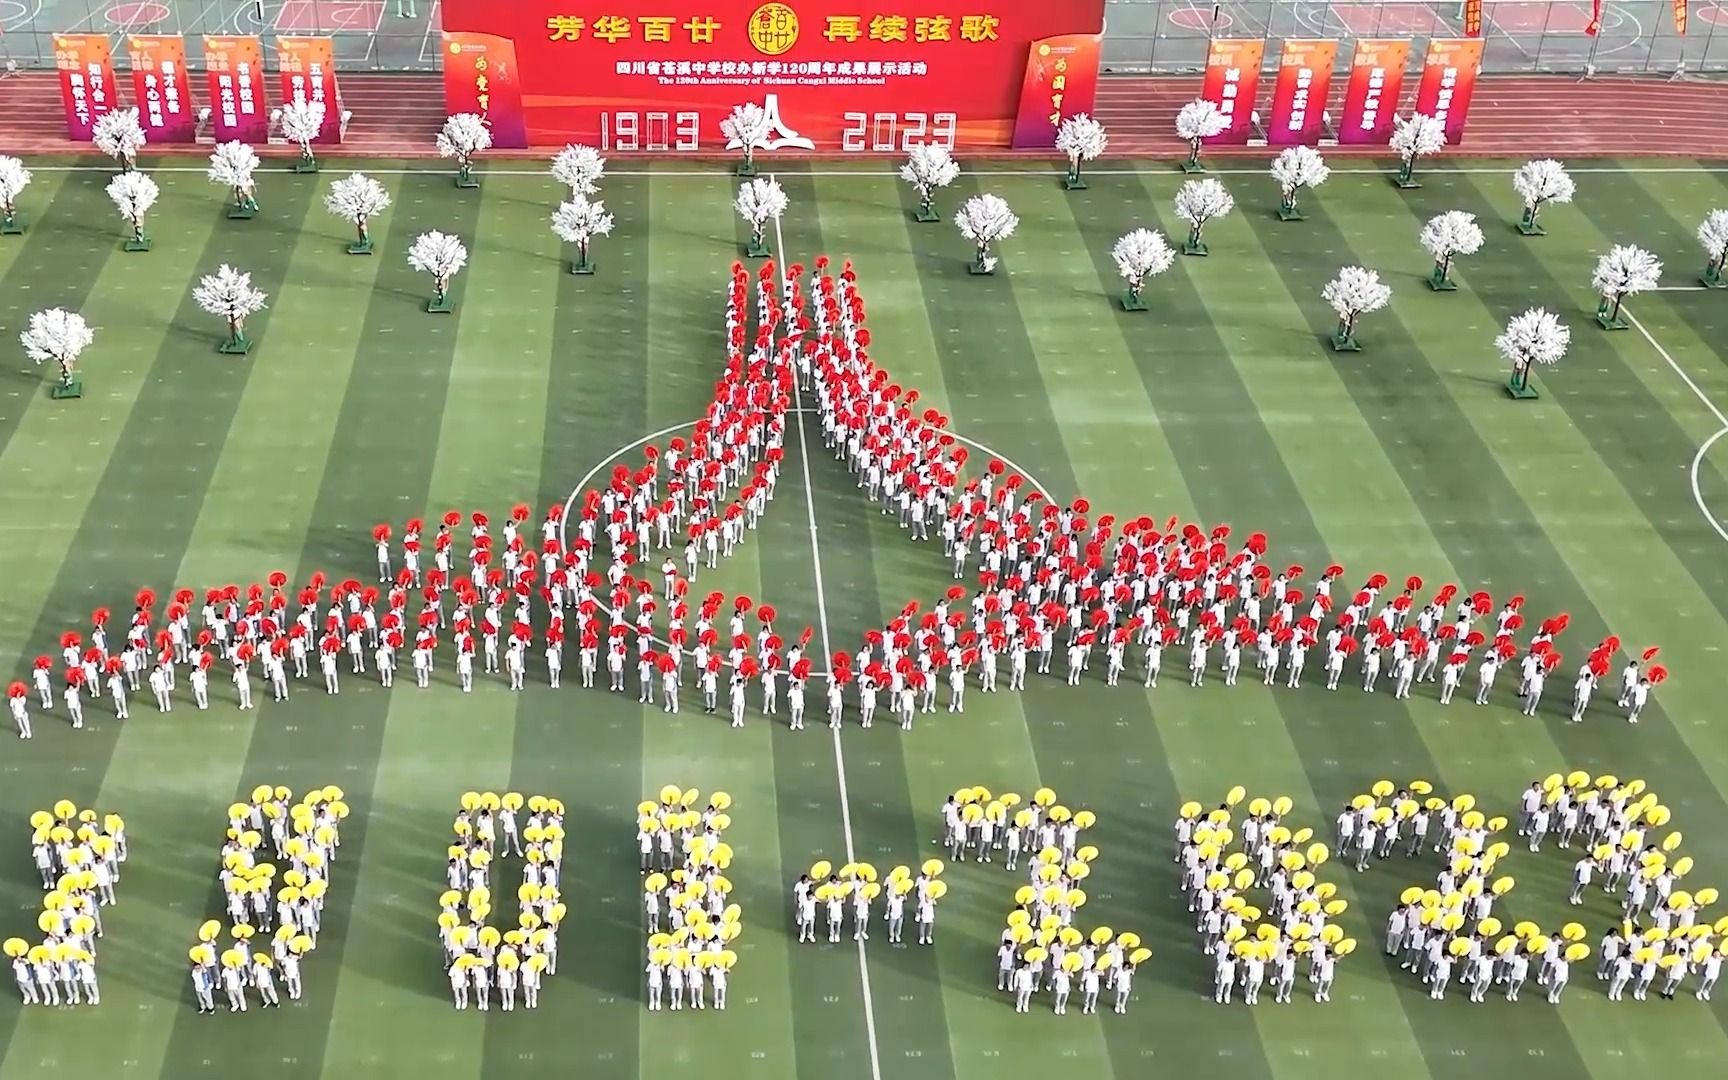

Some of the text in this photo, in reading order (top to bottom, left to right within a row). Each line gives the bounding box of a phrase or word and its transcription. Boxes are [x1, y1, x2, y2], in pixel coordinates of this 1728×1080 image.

[546, 15, 722, 43] 芳华百廿
[823, 14, 1000, 42] 再续弦歌
[88, 63, 108, 111] 知行合一
[615, 61, 928, 76] 四川省苍溪中学校办新学120周年成果展示活动
[658, 76, 886, 87] The 120th Anniversary of Sichuan Cangxi Middle School
[218, 75, 238, 127] 阳光校园
[309, 63, 327, 114] 五育并
[600, 112, 699, 150] 1903
[843, 112, 957, 151] 2023
